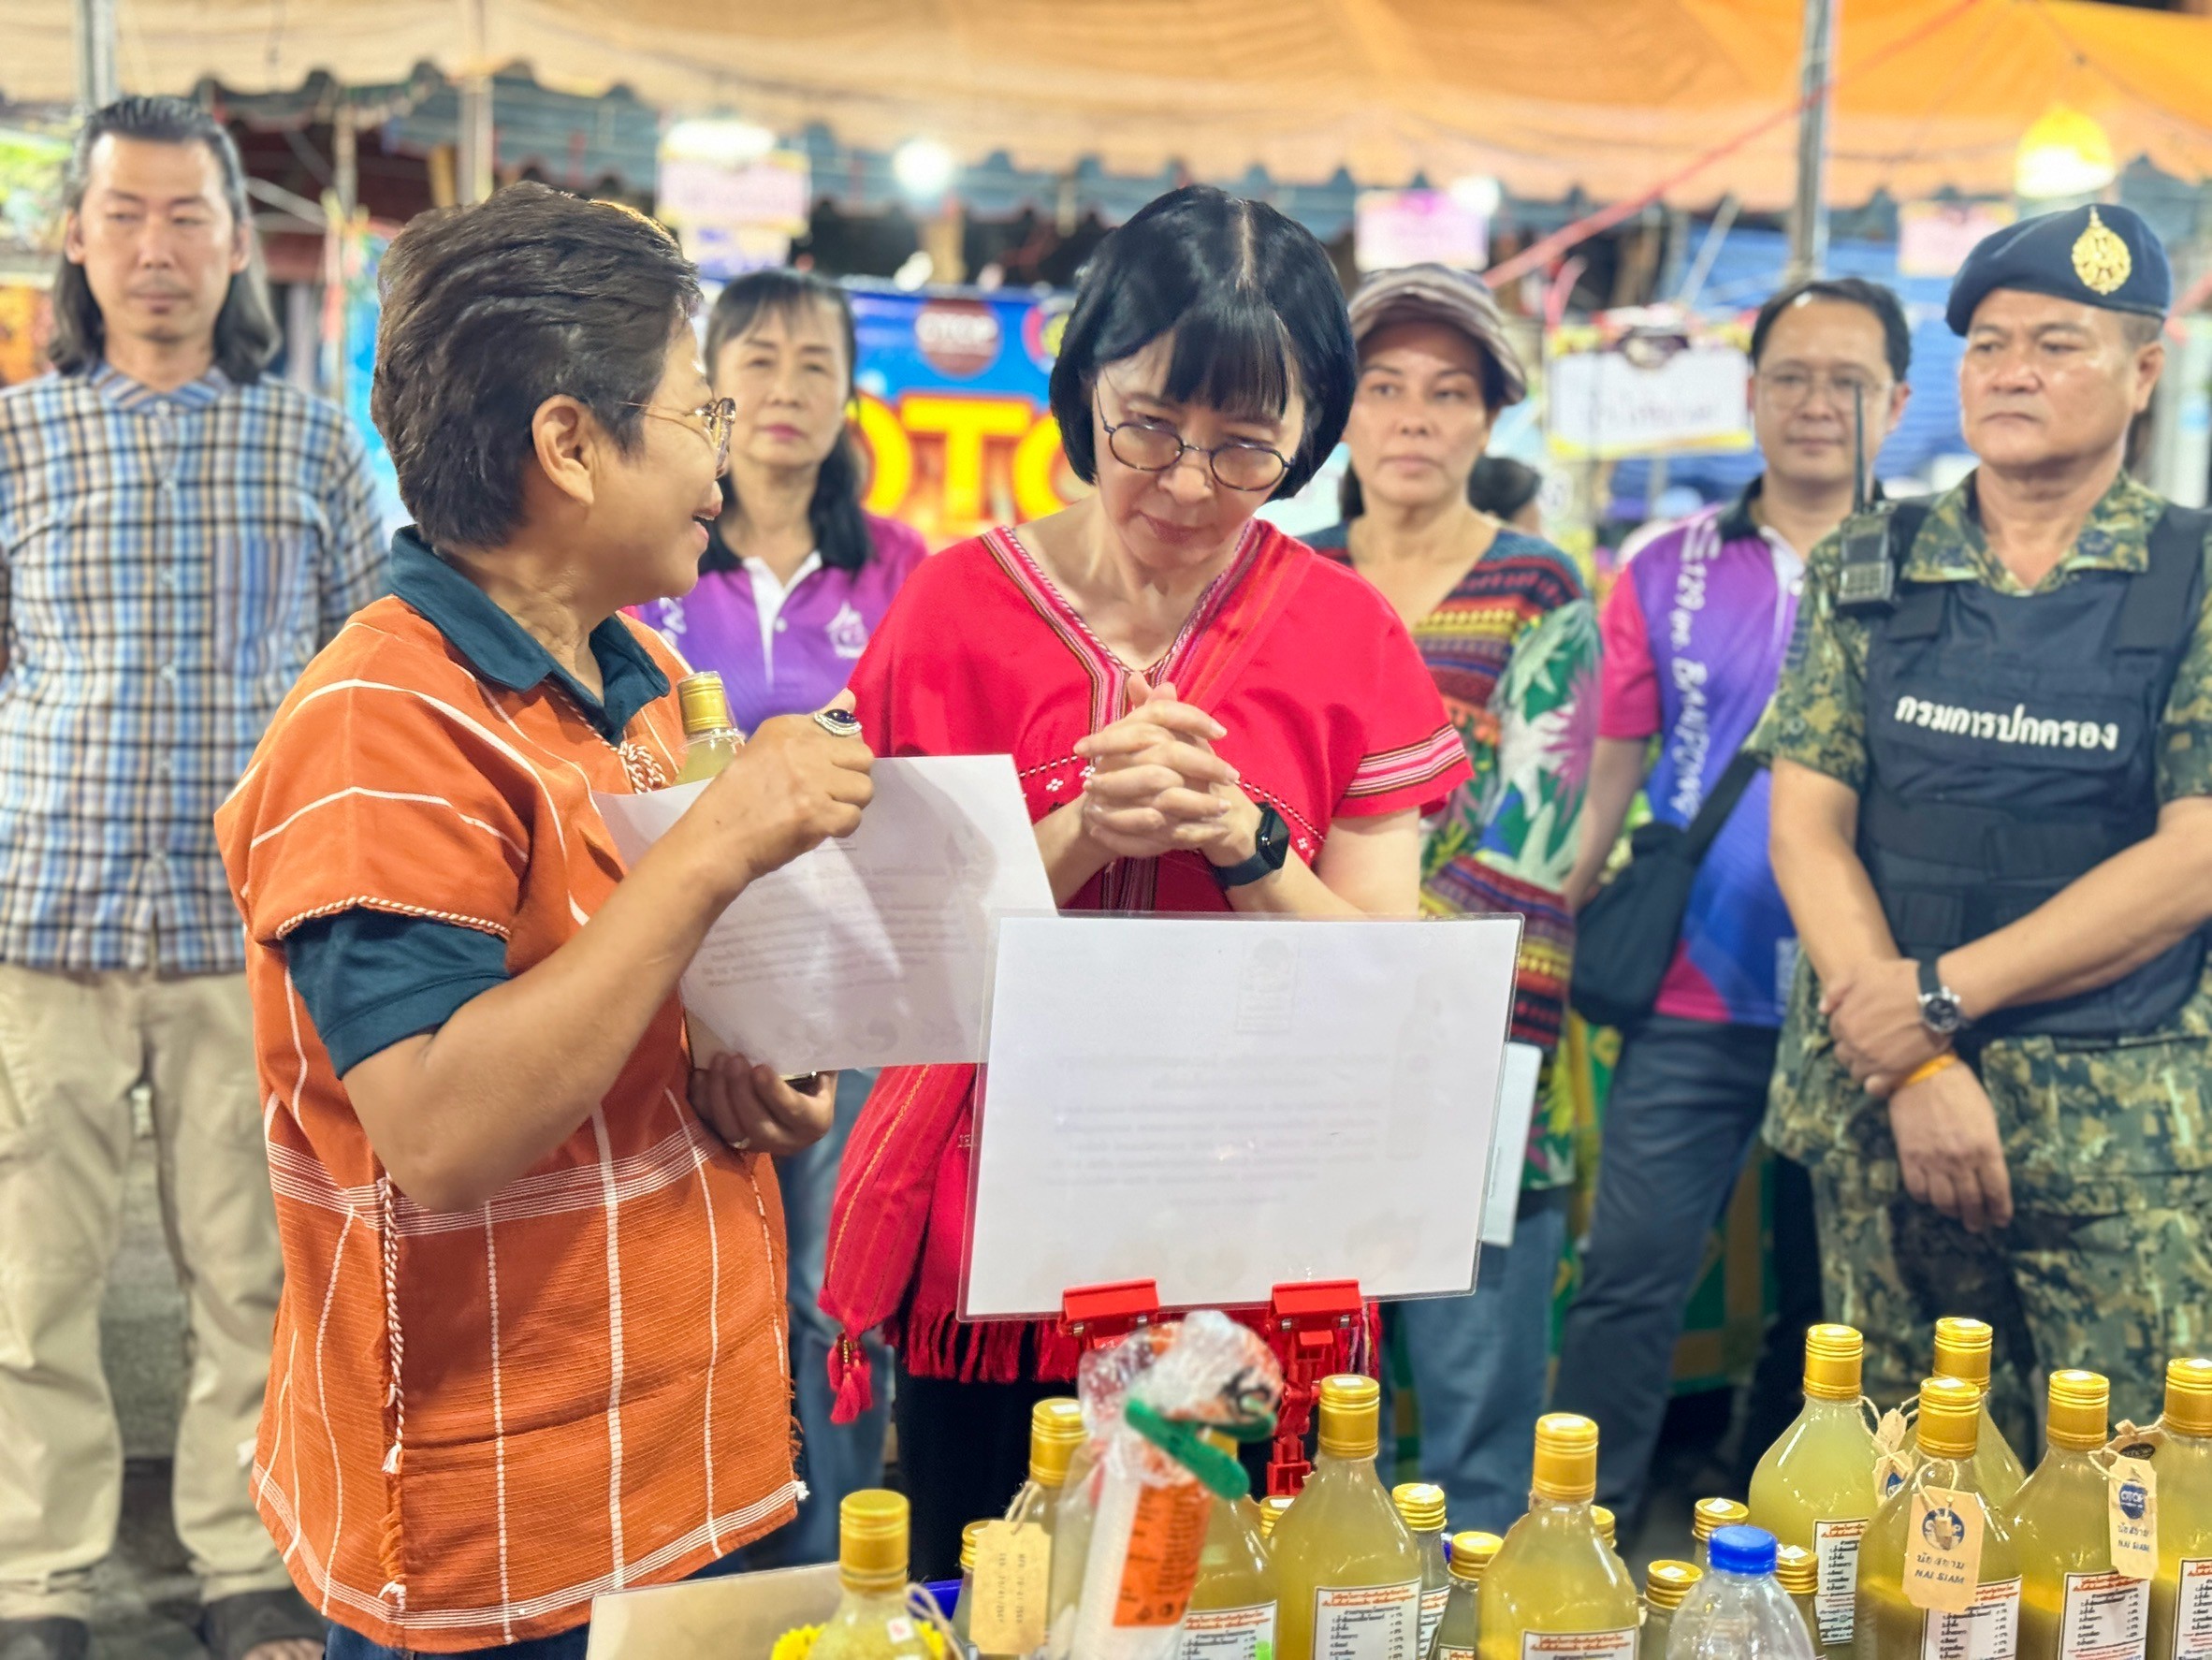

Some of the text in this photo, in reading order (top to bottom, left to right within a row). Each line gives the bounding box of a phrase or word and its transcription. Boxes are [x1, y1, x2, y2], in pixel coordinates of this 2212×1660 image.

[1894, 695, 2119, 751] กรมการปกครอง
[1914, 1569, 1965, 1583] NAI SIAM
